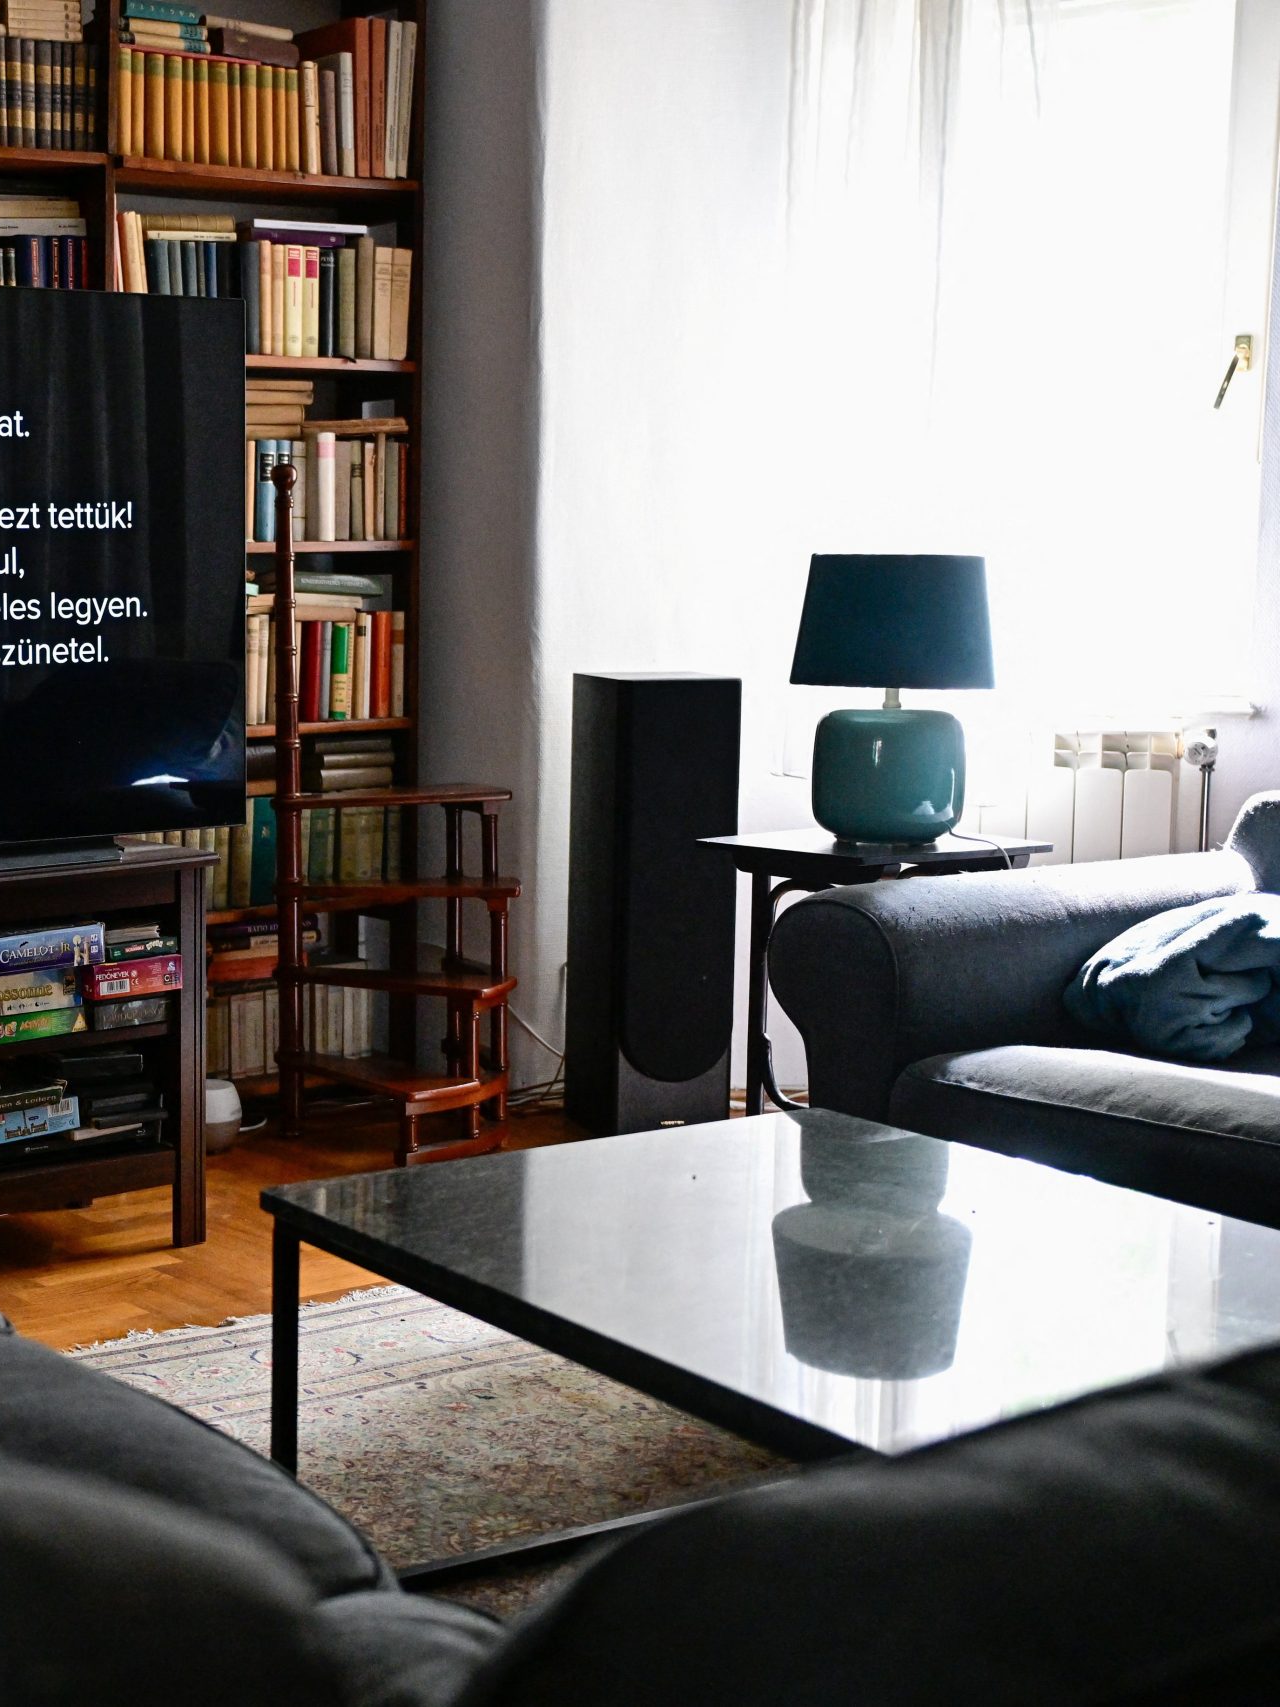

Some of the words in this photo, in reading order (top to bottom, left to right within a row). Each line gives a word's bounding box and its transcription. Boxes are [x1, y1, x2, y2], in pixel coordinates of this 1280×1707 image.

[48, 501, 132, 529] tettük!
[51, 592, 147, 625] legyen.
[0, 945, 55, 964] CAMELOT
[95, 971, 130, 982] FEDŐNEVEK
